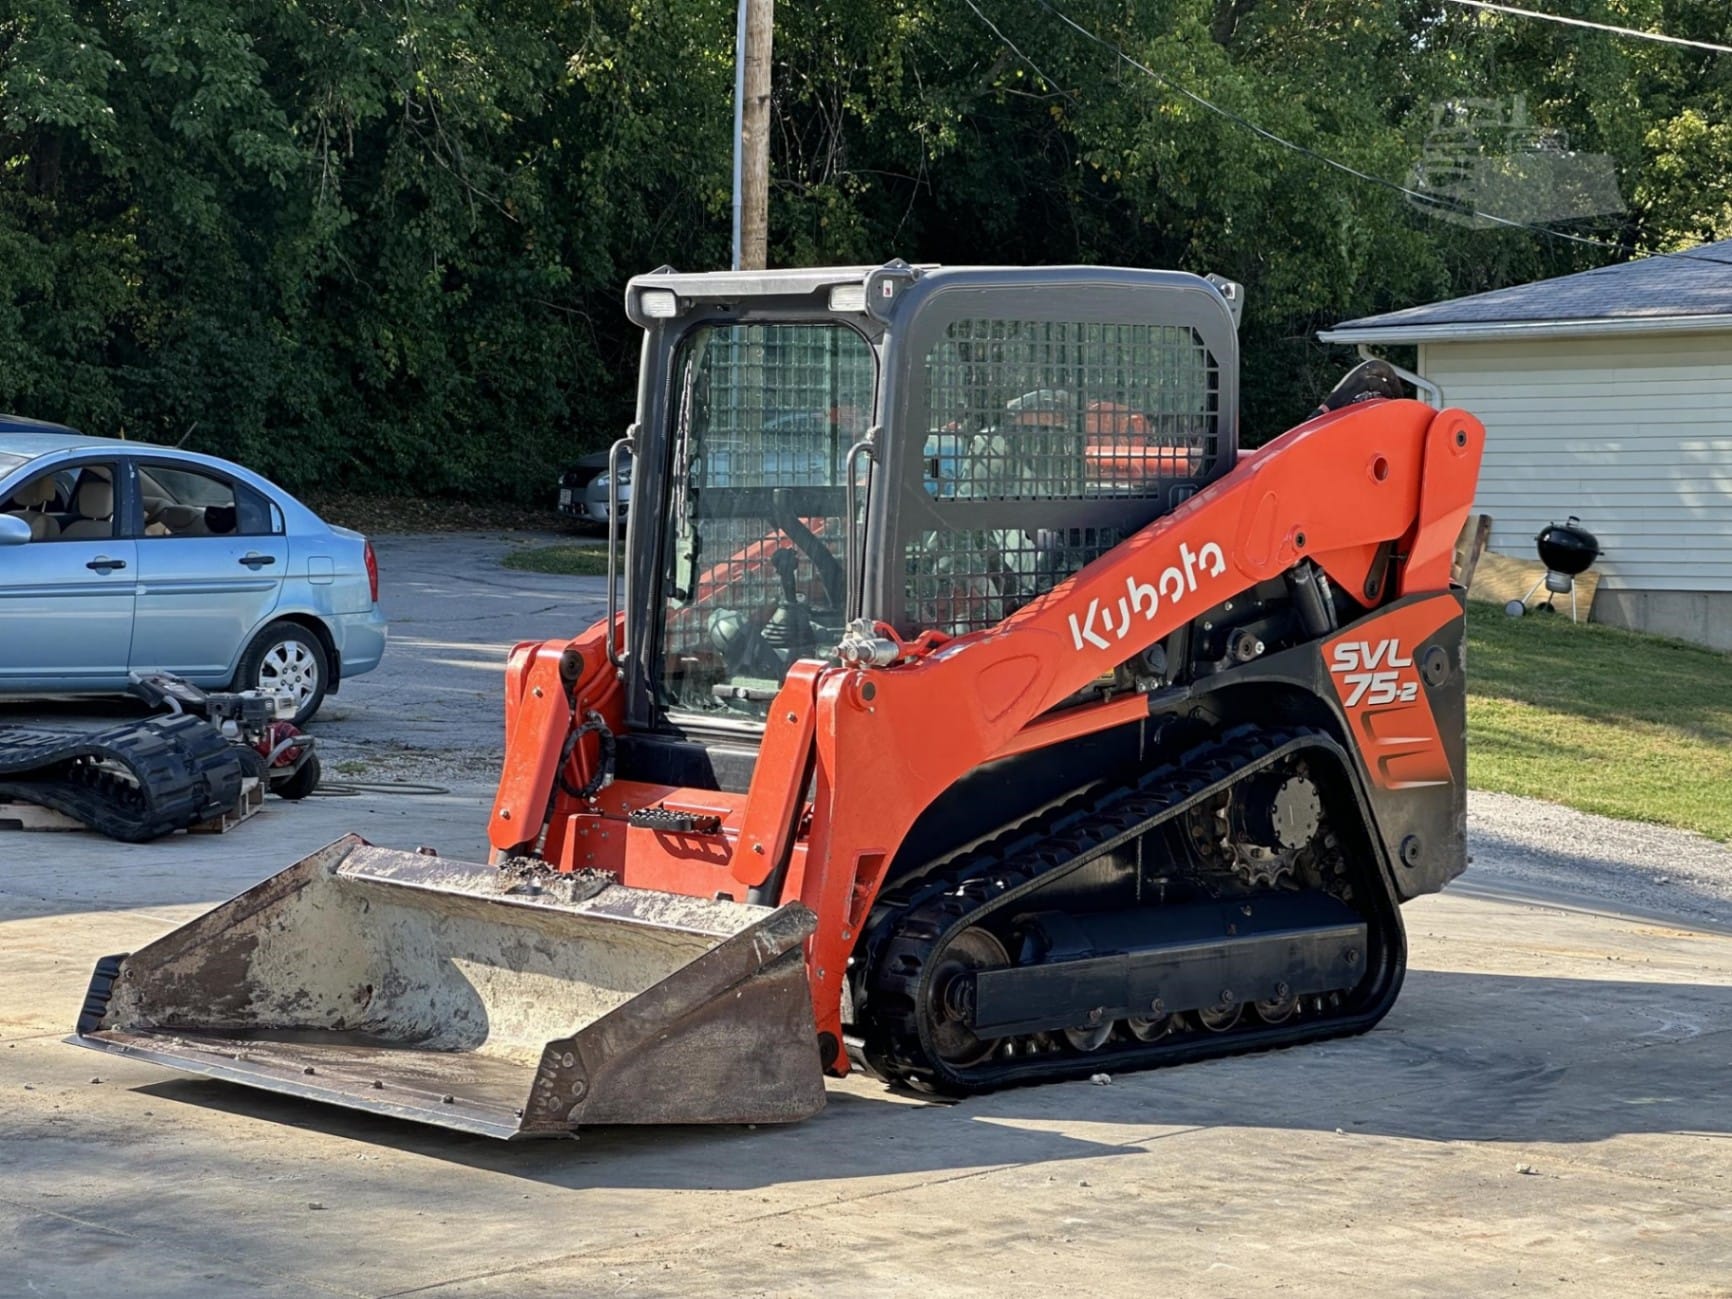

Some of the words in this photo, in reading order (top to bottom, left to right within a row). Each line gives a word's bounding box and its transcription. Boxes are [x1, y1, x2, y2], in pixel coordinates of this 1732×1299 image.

[1068, 542, 1226, 650] Kubota
[1330, 639, 1412, 672] SVL
[1344, 672, 1418, 707] 75-2
